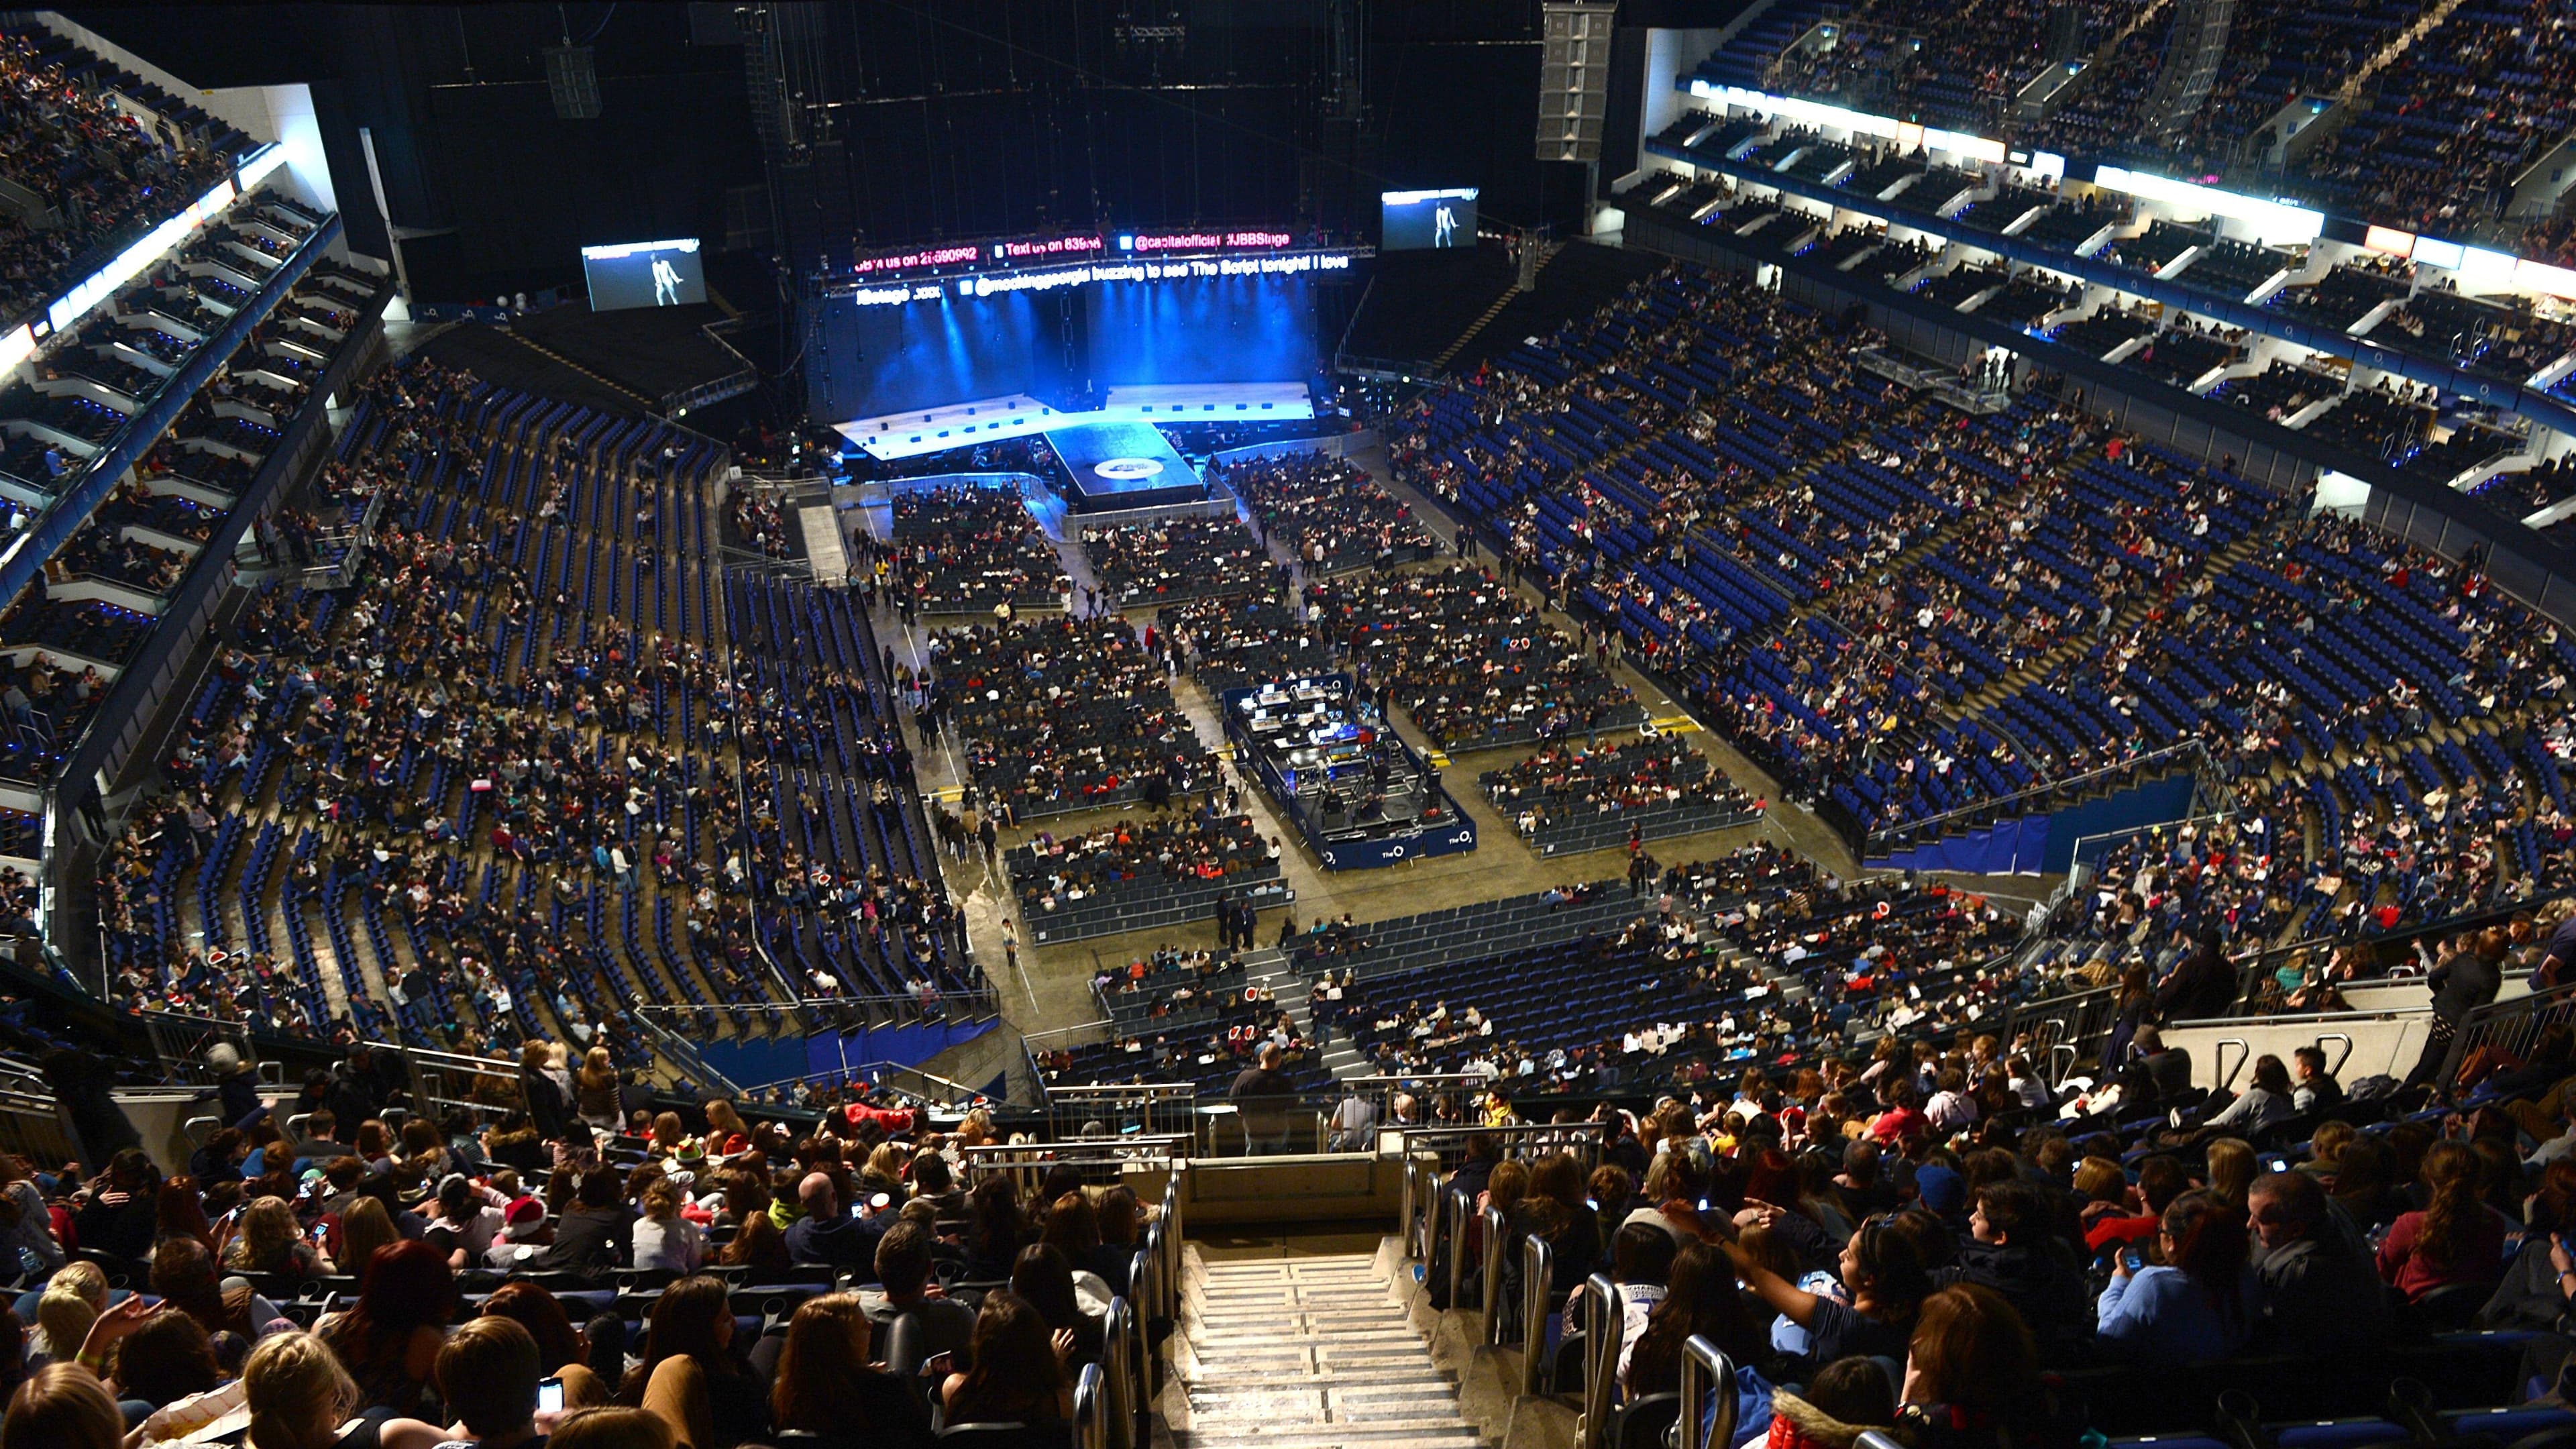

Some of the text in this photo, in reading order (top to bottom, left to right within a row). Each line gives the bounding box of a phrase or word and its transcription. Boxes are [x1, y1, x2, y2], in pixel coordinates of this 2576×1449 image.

[1005, 242, 1030, 256] Text
[1048, 239, 1063, 252] on
[885, 256, 901, 269] us
[902, 254, 918, 266] on
[1091, 266, 1144, 282] buzzing
[1190, 261, 1218, 276] The
[1220, 259, 1259, 276] Script
[1320, 254, 1348, 270] love
